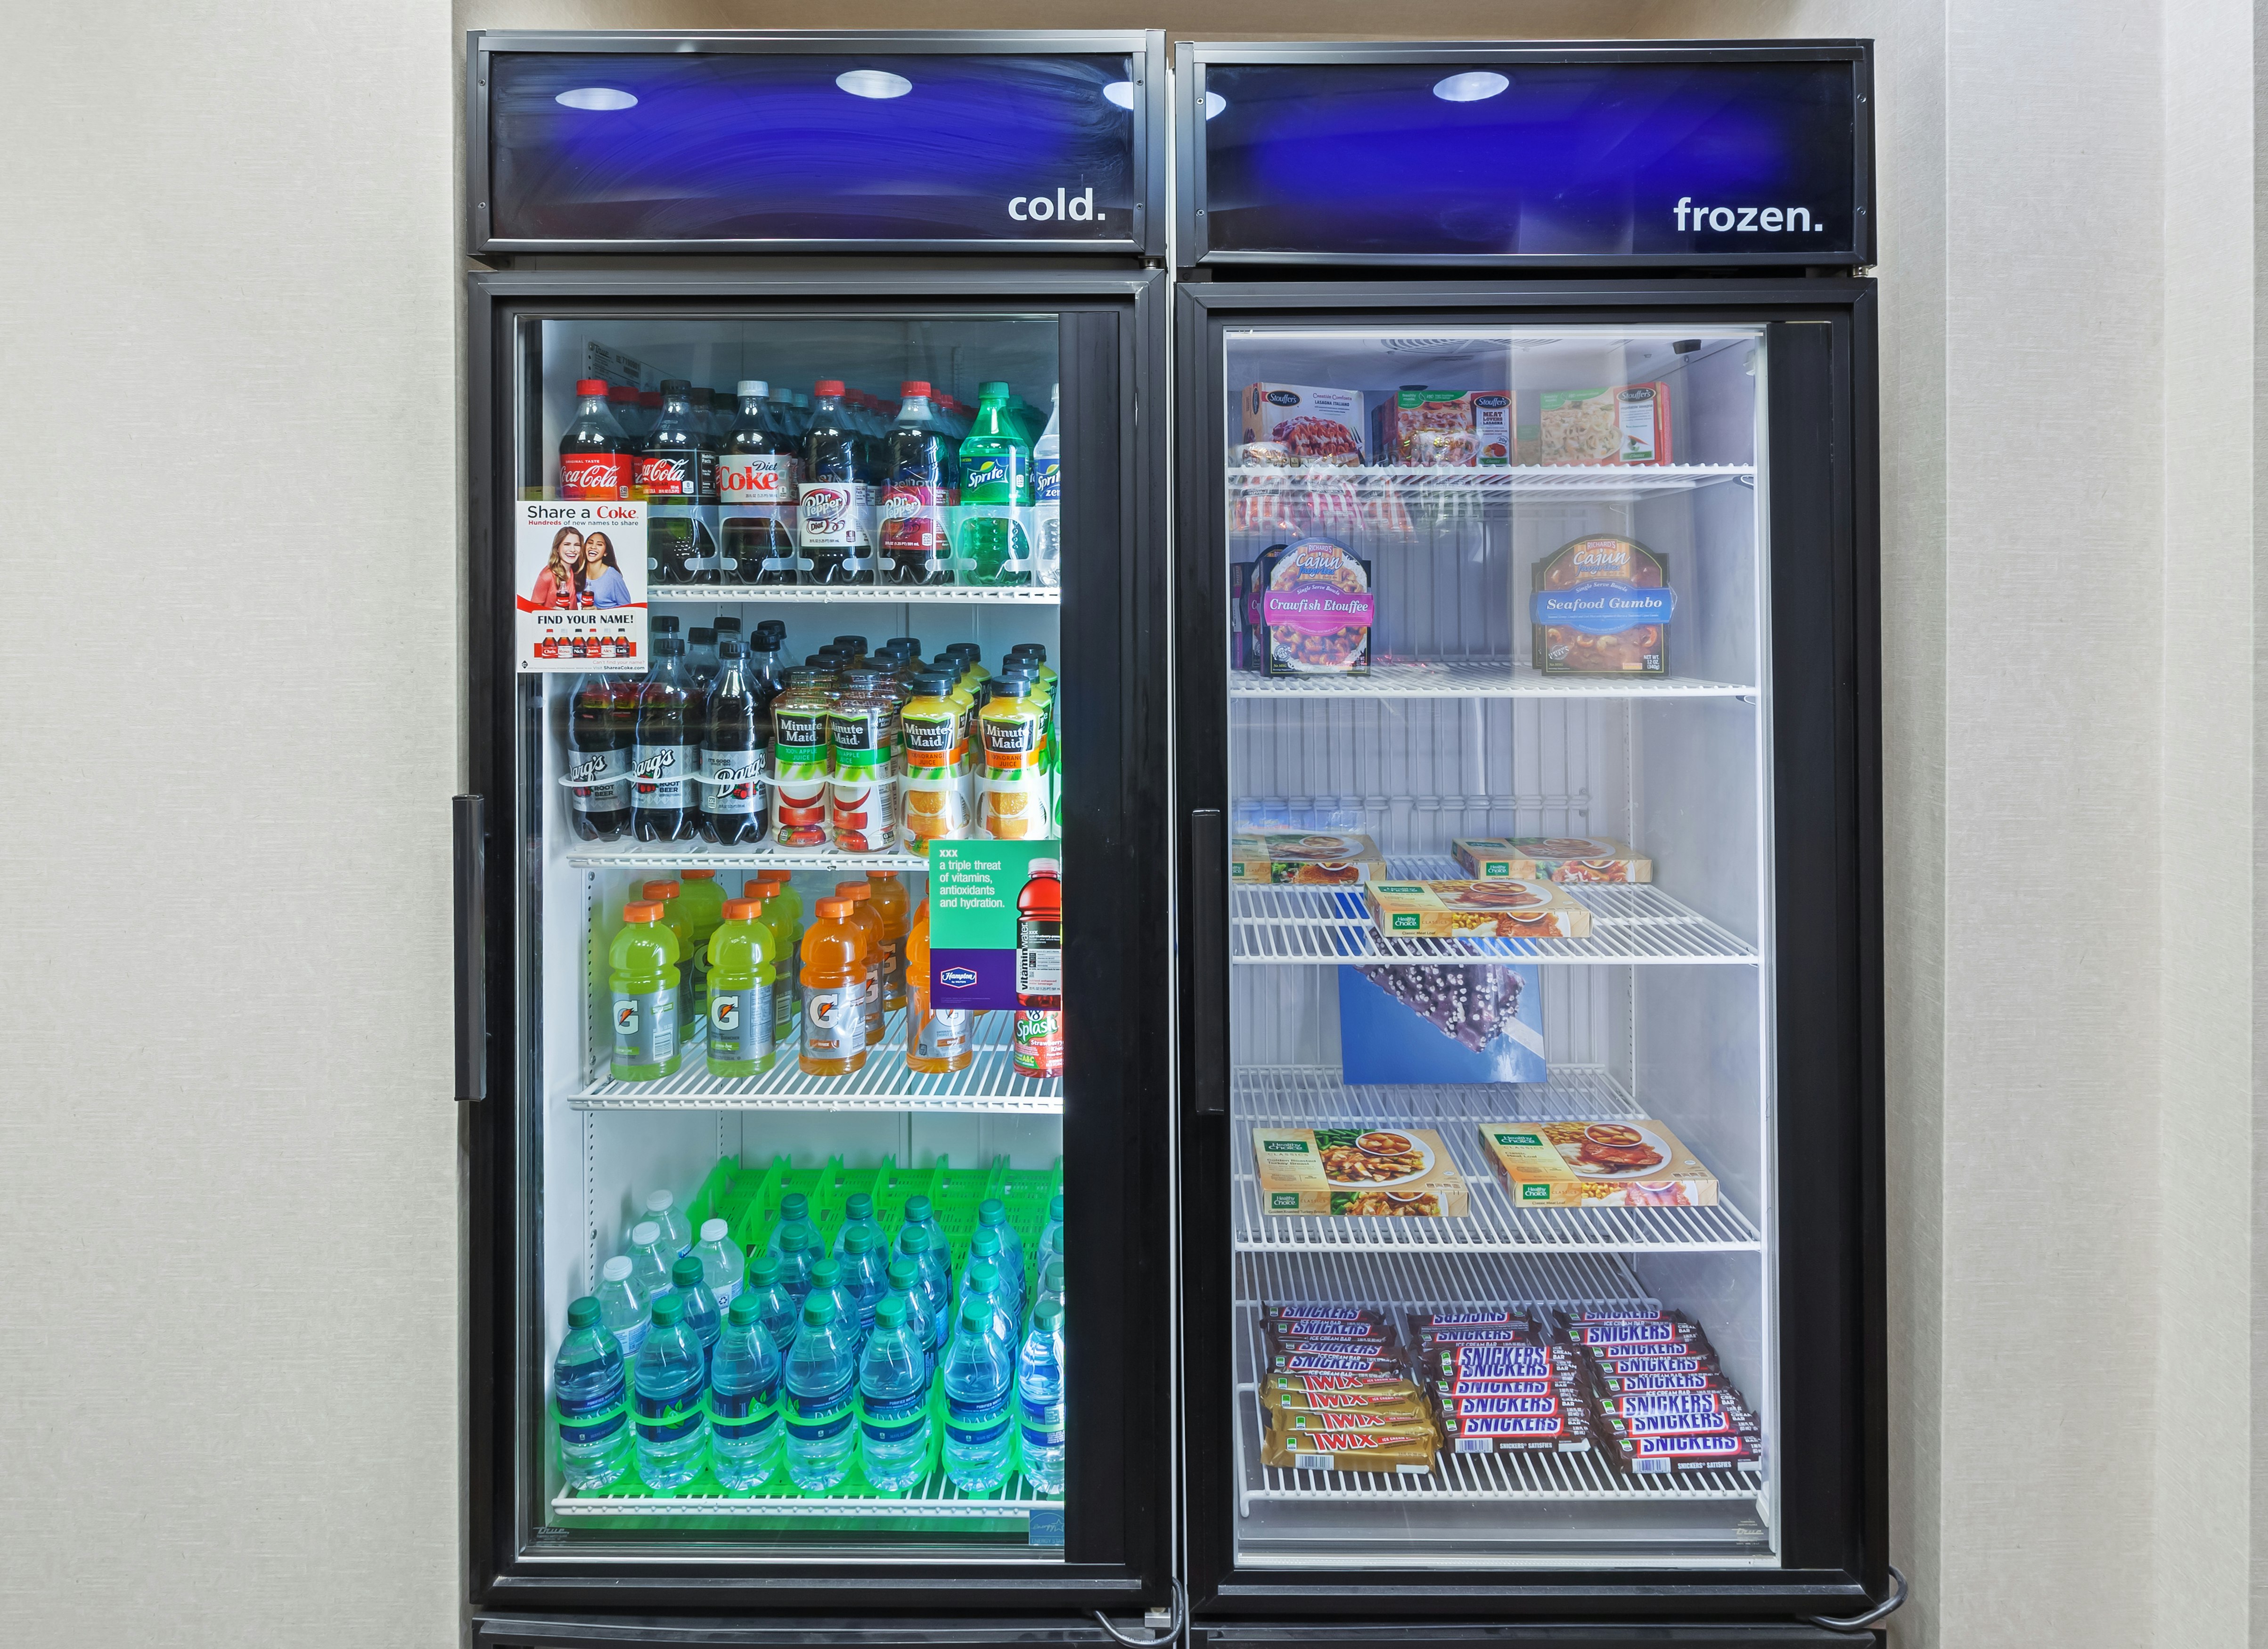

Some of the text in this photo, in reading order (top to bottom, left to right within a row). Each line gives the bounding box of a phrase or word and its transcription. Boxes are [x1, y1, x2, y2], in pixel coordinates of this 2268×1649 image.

[1008, 188, 1105, 221] cold.
[1673, 197, 1823, 232] frozen.
[1270, 393, 1296, 404] Stouffer's
[1621, 390, 1651, 400] Stouffer's
[1479, 398, 1507, 407] Stouffer's
[642, 459, 689, 481] ca-Cola
[752, 461, 777, 471] Diet
[560, 465, 621, 488] Coca-Cola
[720, 465, 779, 491] Coke
[968, 465, 1003, 488] Sprite
[1037, 470, 1060, 491] Sprit
[815, 493, 831, 504] Dr
[893, 497, 908, 506] Dr
[527, 505, 637, 519] Share a Coke
[805, 496, 842, 516] Pepper
[885, 499, 917, 518] Pepper
[811, 522, 823, 531] Diet
[1308, 544, 1333, 554] RICHARD'S
[1587, 542, 1616, 550] RICHARD'S
[1296, 552, 1343, 569] Cajun
[1573, 549, 1630, 565] Cajun
[1297, 567, 1336, 578] favorites
[1575, 564, 1621, 576] favorites
[1297, 586, 1310, 595] Single
[1326, 586, 1340, 595] Bowls
[1576, 583, 1593, 593] Single
[1610, 582, 1628, 592] Bowls
[1269, 598, 1368, 614] Crawfish Etouffee
[1547, 597, 1662, 612] Seafood Gumbo
[538, 615, 634, 624] FIND YOUR NAME!
[781, 719, 822, 731] Minute
[905, 723, 949, 735] Minute
[987, 724, 1029, 737] Minut
[786, 731, 817, 742] Maid
[834, 733, 858, 745] Maid
[911, 735, 942, 747] Maid
[991, 736, 1023, 748] Maid
[569, 756, 605, 782] arq's
[714, 753, 766, 797] Barq's
[949, 860, 971, 872] triple
[974, 861, 1001, 870] threat
[940, 873, 993, 883] of vitamins,
[940, 885, 995, 895] antioxidants
[940, 898, 1005, 909] and hydration.
[942, 972, 975, 980] Hampton
[711, 996, 739, 1031] G
[810, 993, 839, 1029] G
[613, 1000, 639, 1035] G
[1017, 1015, 1058, 1042] Splash
[1284, 1307, 1360, 1319] SNICKERS
[1292, 1323, 1371, 1335] SNICKERS
[1589, 1324, 1671, 1342] SNICKERS
[1438, 1331, 1513, 1341] SNICKERS
[1300, 1343, 1382, 1355] SNICKERS
[1610, 1344, 1685, 1355] SNICKERS
[1461, 1347, 1547, 1365] SNICKERS
[1462, 1365, 1547, 1377] SNICKERS
[1620, 1360, 1696, 1372] SNICKERS
[1295, 1375, 1364, 1390] TWIX
[1459, 1382, 1546, 1393] SNICKERS
[1627, 1375, 1705, 1389] SNICKERS
[1300, 1391, 1368, 1410] TWIX
[1464, 1397, 1554, 1413] SNICKERS
[1625, 1394, 1715, 1416] SNICKERS
[1314, 1412, 1385, 1432] TWIX
[1468, 1418, 1560, 1432] SNICKERS
[1635, 1413, 1724, 1431] SNICKERS
[1305, 1432, 1378, 1453] TWIX
[1643, 1437, 1736, 1453] SNICKERS
